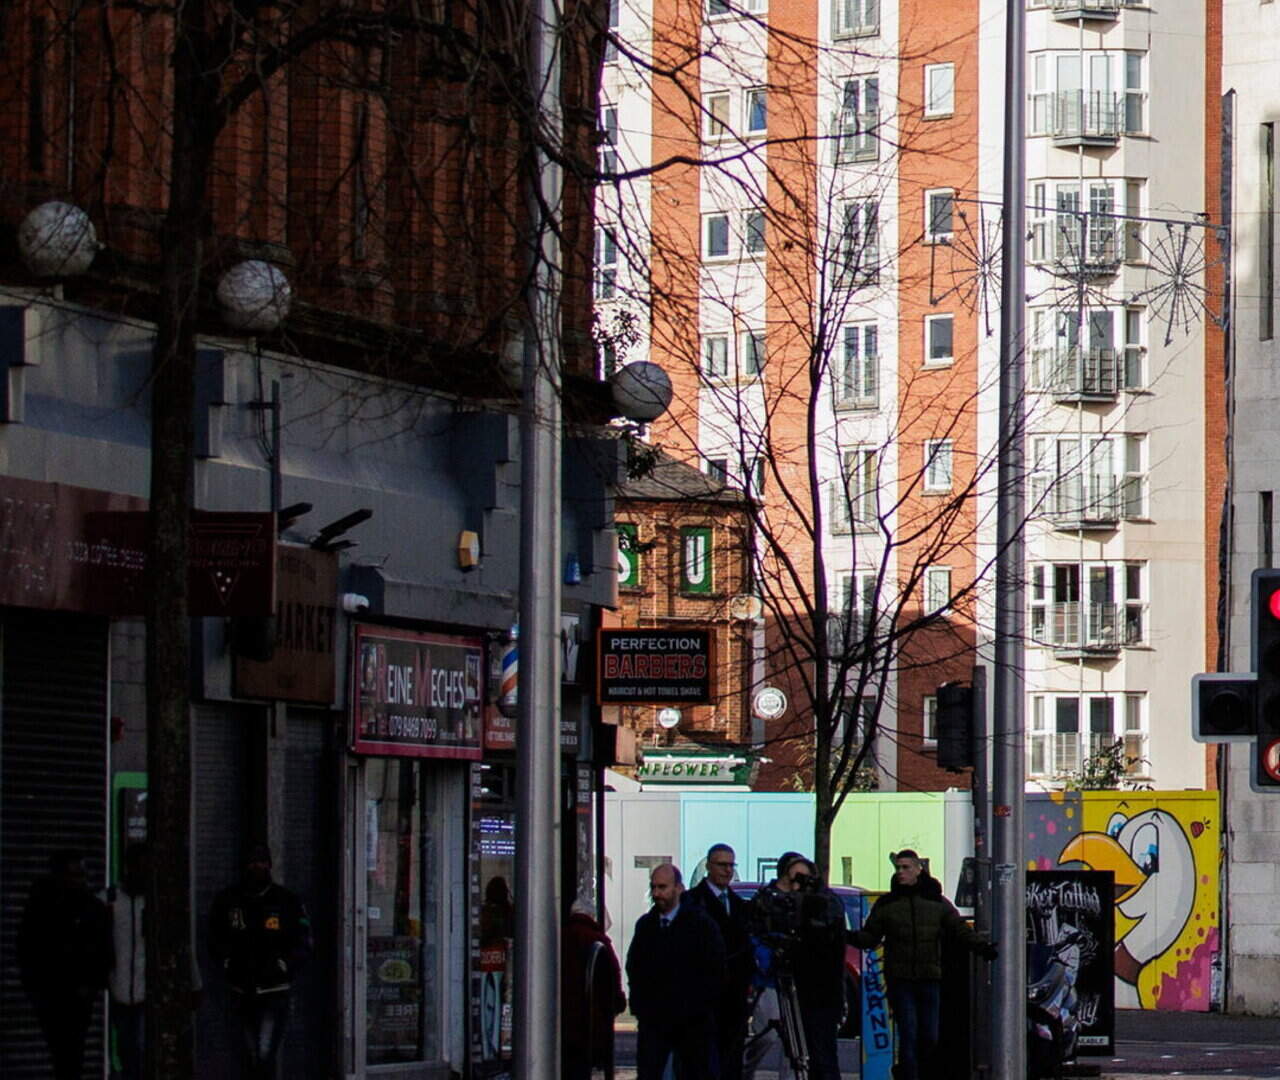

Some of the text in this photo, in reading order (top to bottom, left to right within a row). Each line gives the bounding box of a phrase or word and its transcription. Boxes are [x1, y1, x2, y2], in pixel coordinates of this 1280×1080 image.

[611, 638, 701, 650] PERFECTION
[604, 653, 707, 680] BARBERS
[638, 762, 721, 777] NFLOWER
